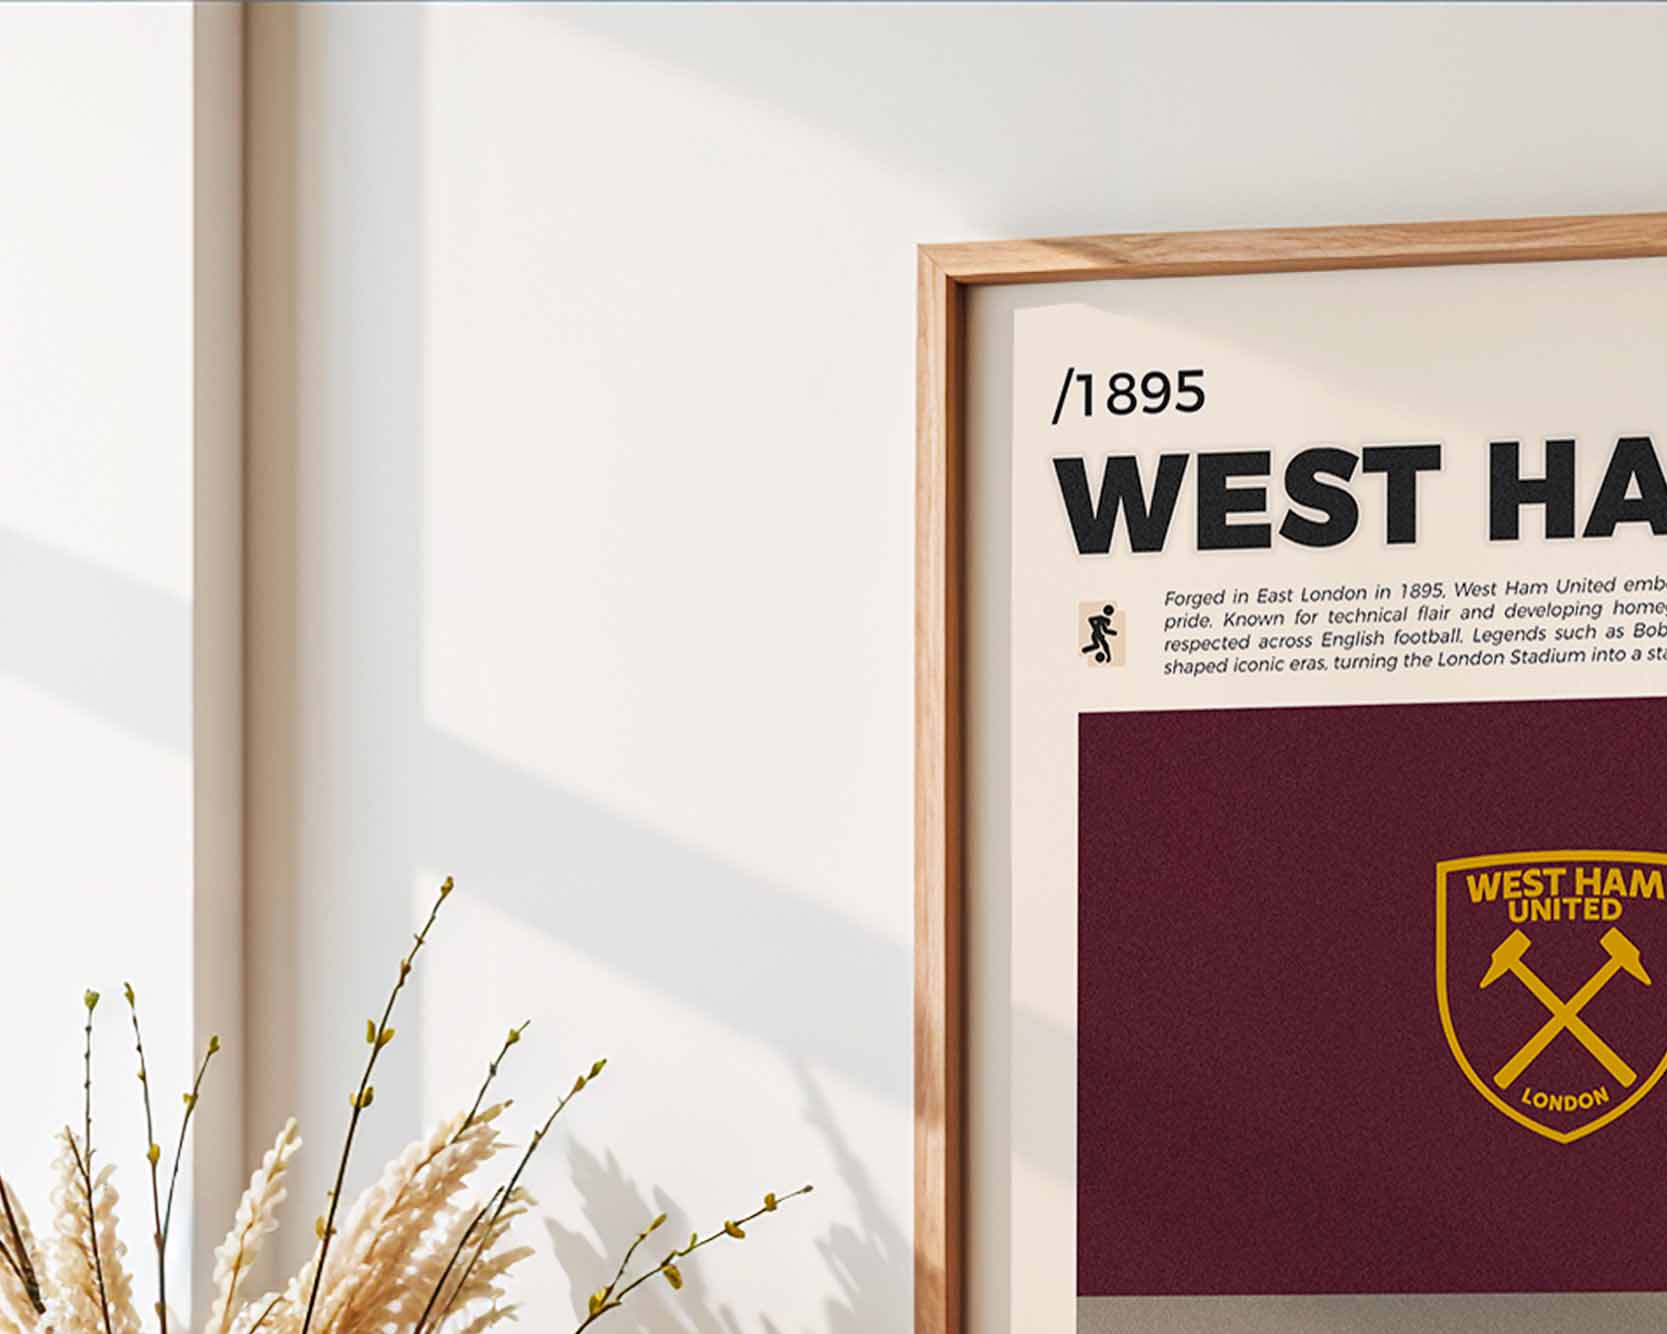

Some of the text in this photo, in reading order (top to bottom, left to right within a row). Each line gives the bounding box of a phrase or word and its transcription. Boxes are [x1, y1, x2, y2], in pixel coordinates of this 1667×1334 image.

[1050, 365, 1206, 426] /1895
[1051, 443, 1443, 556] WEST
[1163, 588, 1227, 611] Forged
[1231, 588, 1250, 605] in
[1256, 587, 1295, 605] East
[1300, 585, 1368, 604] London
[1374, 583, 1392, 601] in
[1453, 581, 1498, 598] West
[1504, 579, 1549, 597] Ham
[1555, 575, 1618, 596] United
[1163, 611, 1213, 633] pride.
[1222, 611, 1286, 628] Known
[1293, 608, 1320, 626] for
[1327, 605, 1409, 625] technical
[1417, 603, 1452, 622] flair
[1459, 602, 1496, 622] and
[1503, 599, 1604, 622] developing
[1163, 633, 1252, 655] respected
[1257, 634, 1313, 651] across
[1320, 629, 1385, 651] English
[1393, 627, 1464, 646] football.
[1472, 625, 1547, 647] Legends
[1553, 623, 1598, 642] such
[1604, 625, 1625, 640] as
[1163, 657, 1230, 678] shaped
[1232, 655, 1286, 673] iconic
[1333, 652, 1399, 673] turning
[1403, 651, 1434, 669] the
[1437, 649, 1506, 668] London
[1509, 647, 1587, 666] Stadium
[1590, 645, 1627, 663] into
[1630, 648, 1643, 662] a
[1466, 867, 1665, 903] WEST HAM
[1508, 896, 1623, 923] UNITED
[1521, 1086, 1609, 1112] LONDON
